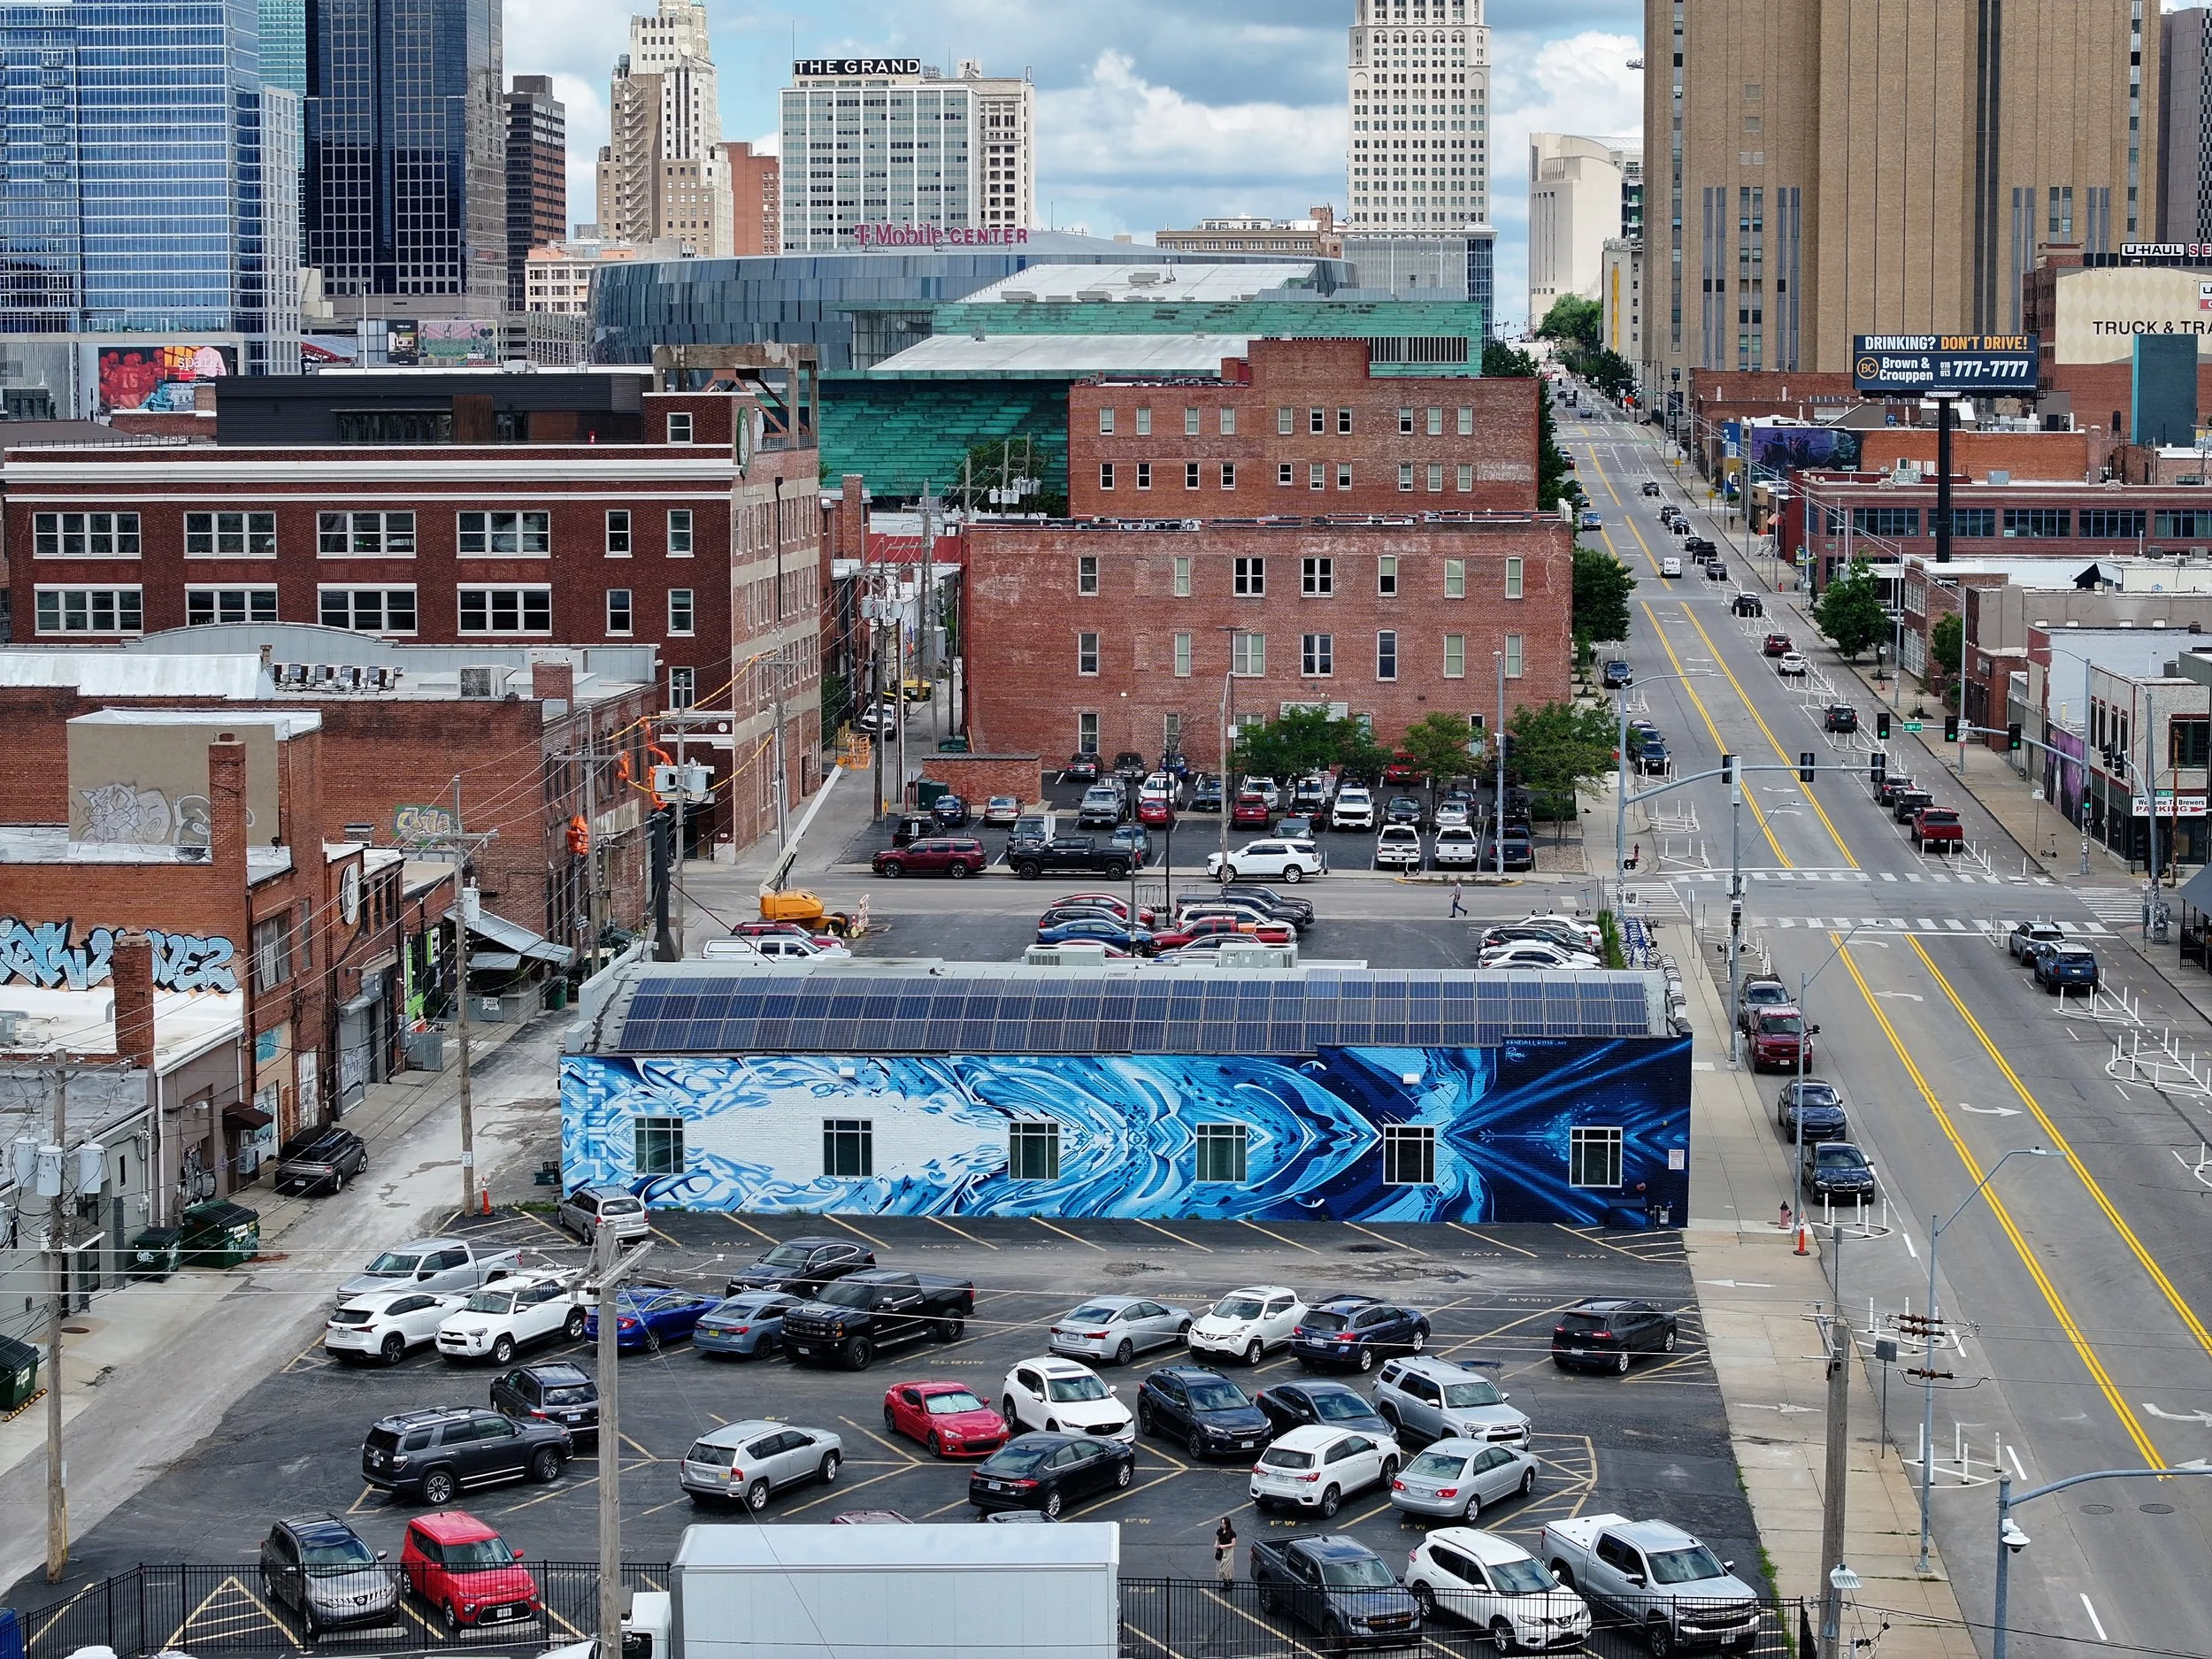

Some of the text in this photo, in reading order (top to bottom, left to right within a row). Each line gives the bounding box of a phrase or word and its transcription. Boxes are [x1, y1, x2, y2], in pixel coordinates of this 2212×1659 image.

[795, 59, 919, 73] THE GRAND
[949, 228, 1027, 244] CENTER
[2124, 245, 2181, 255] U-HAUL
[2093, 320, 2158, 334] TRUCK
[2163, 320, 2174, 334] &
[1865, 336, 2028, 350] DRINKING? DON'T DRIVE!
[1861, 363, 1876, 373] BC
[1882, 357, 1930, 369] Brown &
[1953, 360, 2029, 378] 777-7777
[122, 373, 139, 388] 16
[1879, 369, 1933, 383] Crouppen
